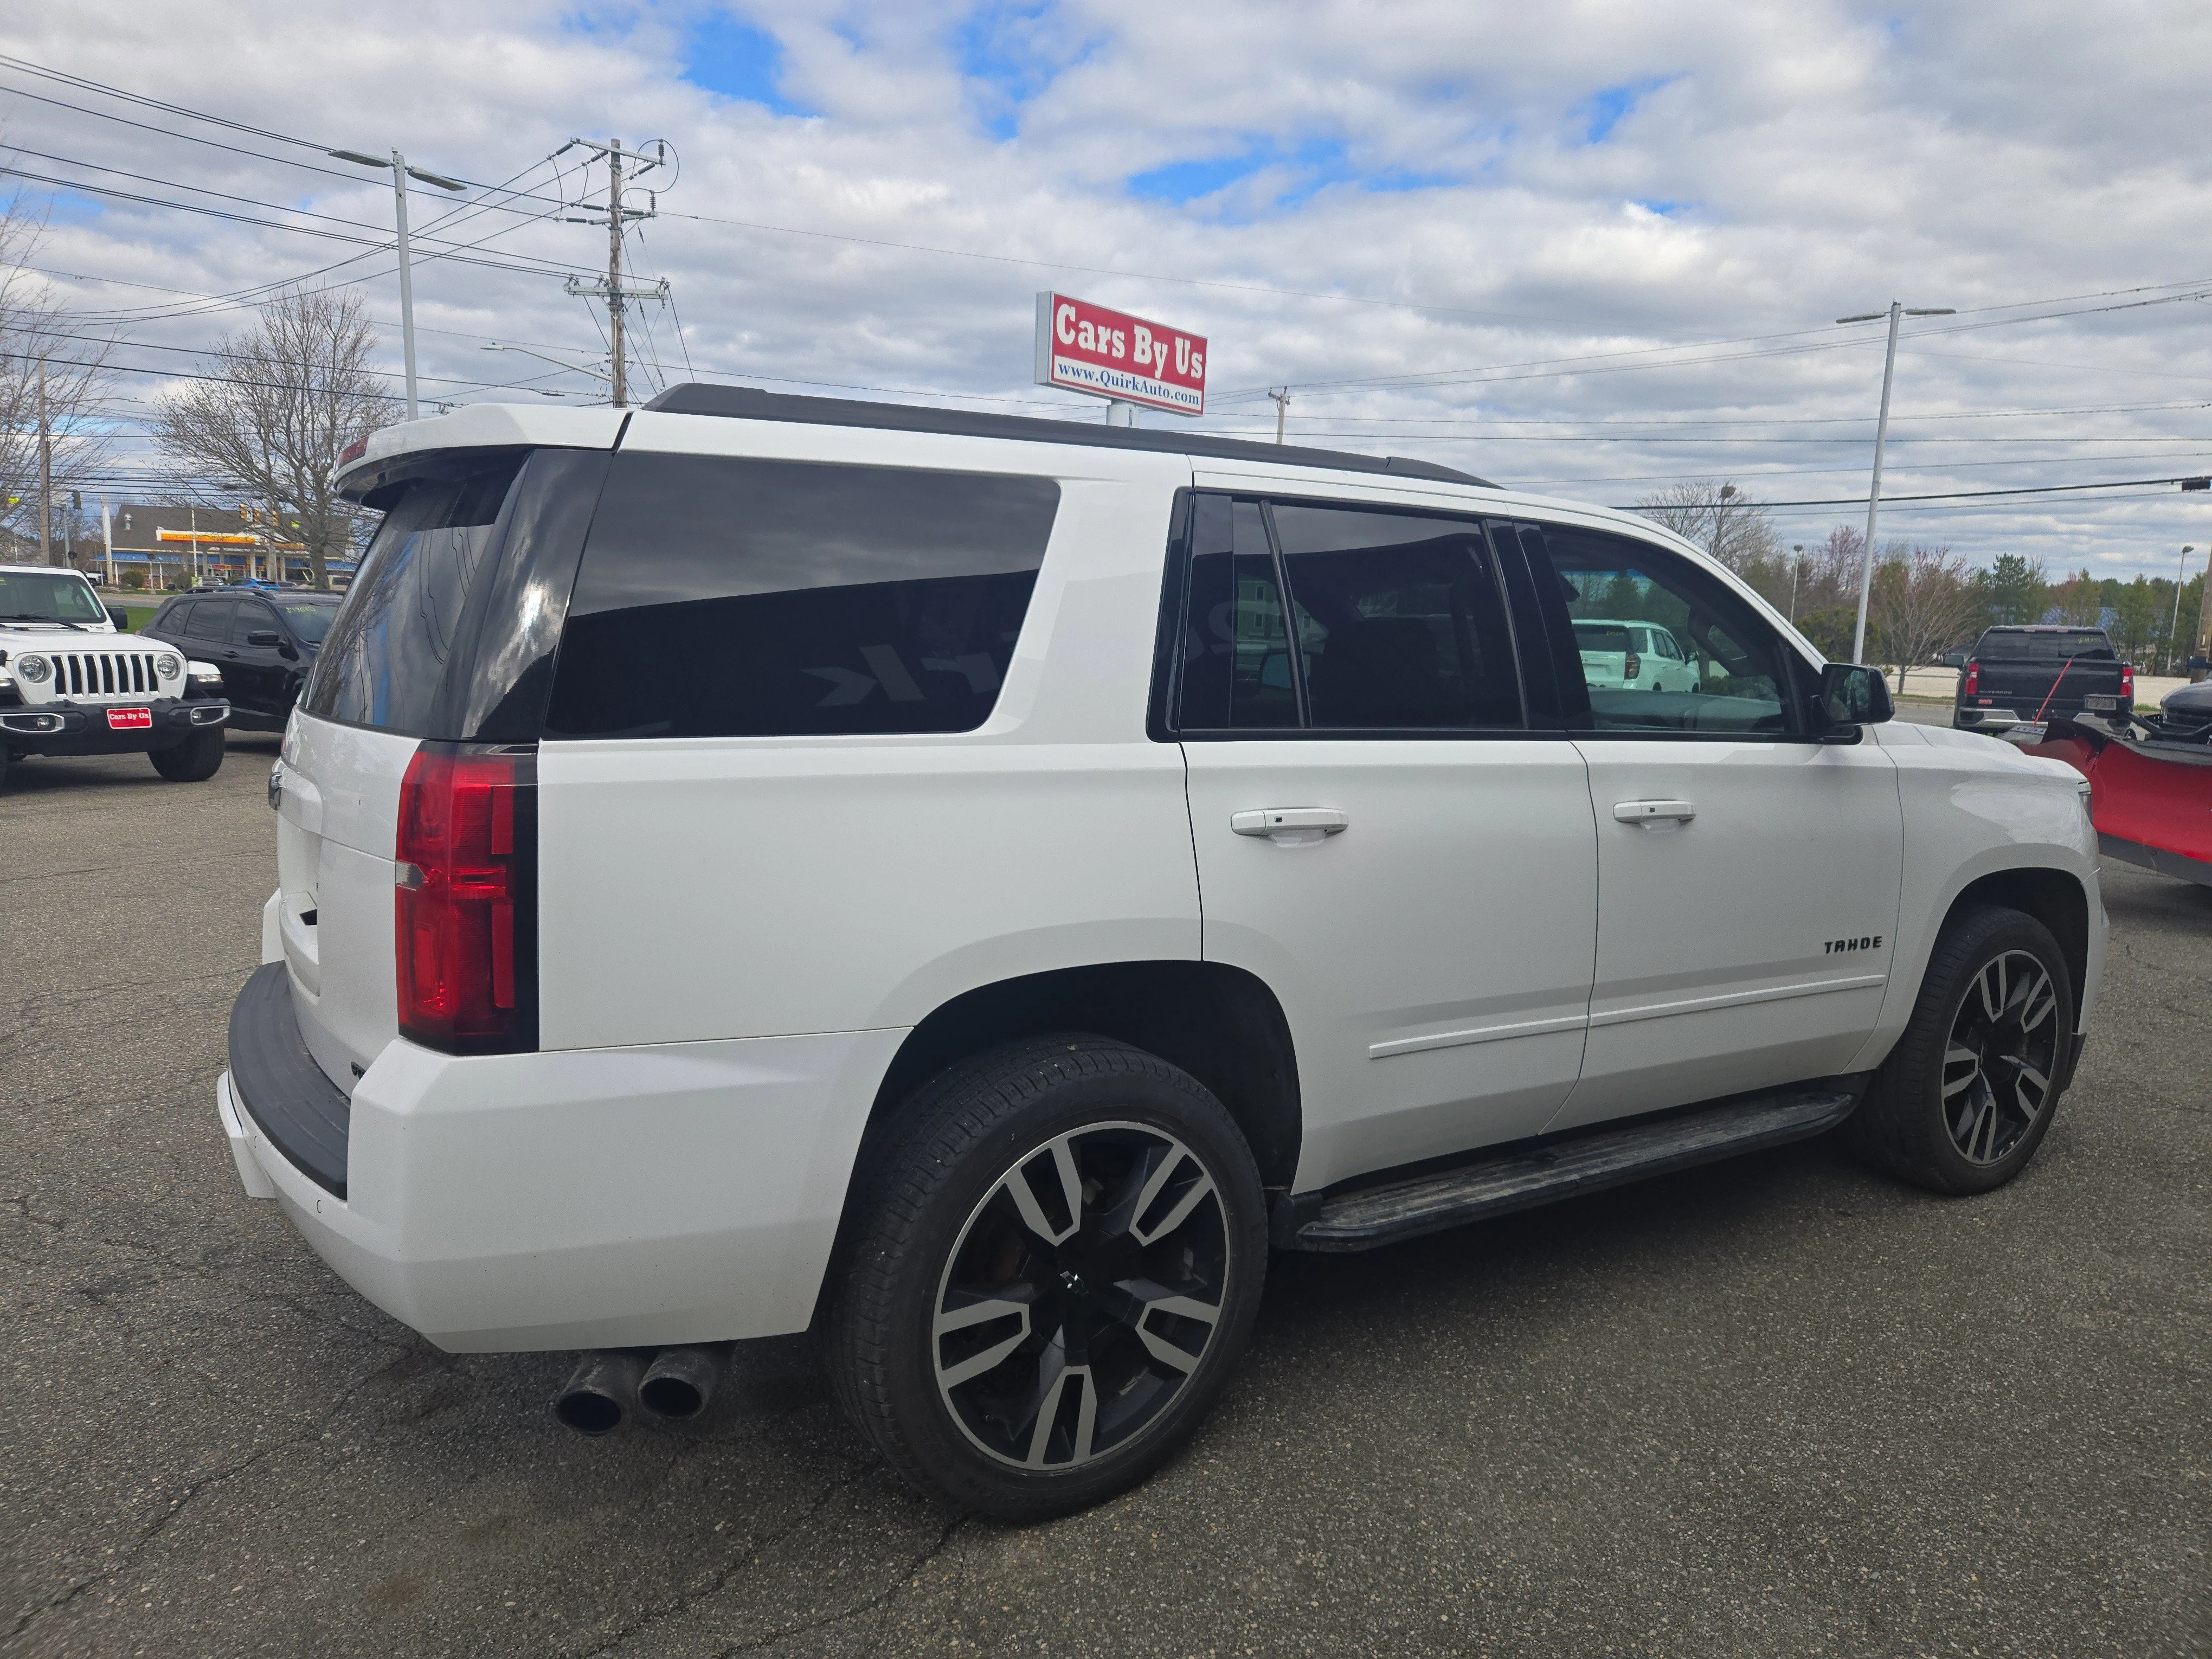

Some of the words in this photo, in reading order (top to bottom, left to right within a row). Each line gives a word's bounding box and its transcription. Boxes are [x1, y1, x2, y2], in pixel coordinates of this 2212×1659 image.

[1056, 304, 1125, 358] Cars
[1134, 324, 1168, 379] By
[1175, 336, 1203, 378] Us
[1057, 363, 1199, 406] www.QuirkAuto.com
[1824, 935, 1882, 954] TAHOE
